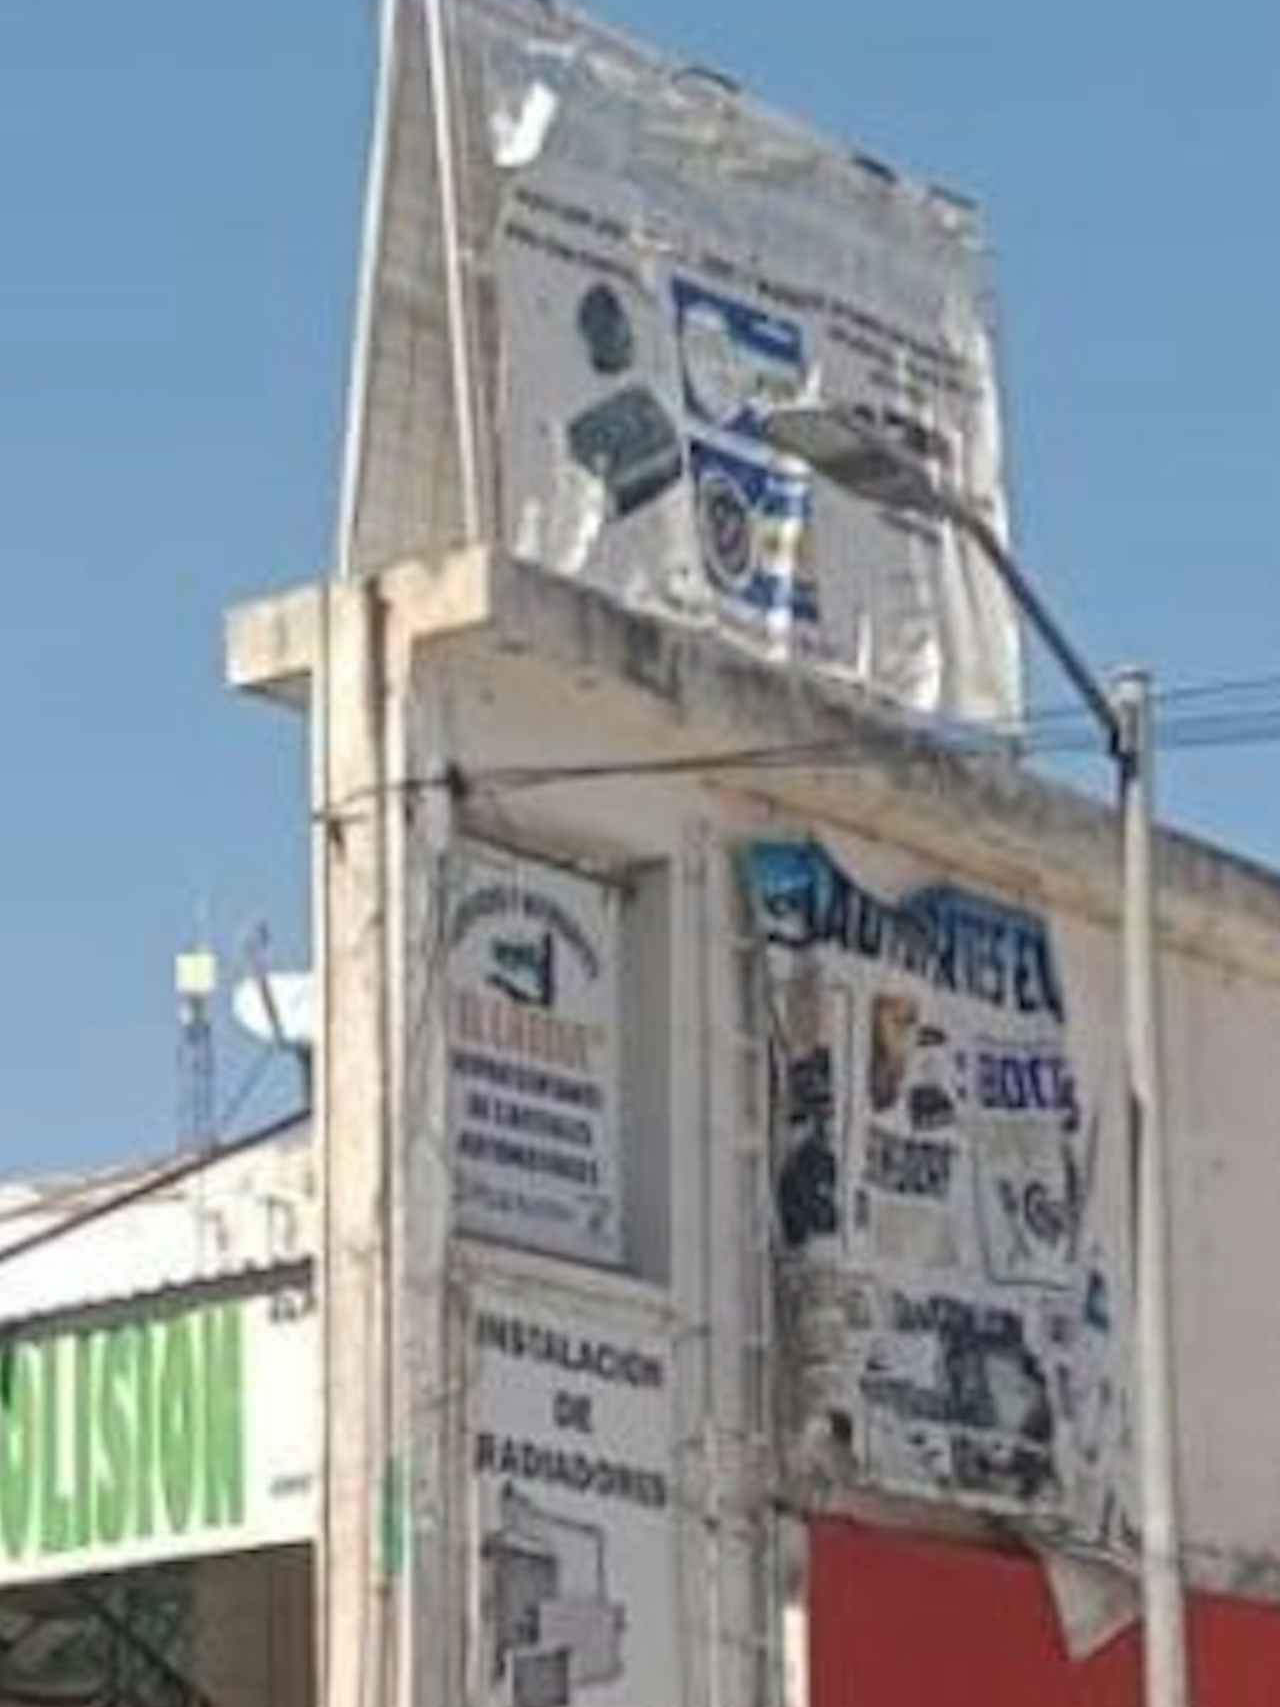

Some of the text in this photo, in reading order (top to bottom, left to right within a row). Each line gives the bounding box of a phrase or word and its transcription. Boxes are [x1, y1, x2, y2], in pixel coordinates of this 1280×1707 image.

[476, 1310, 664, 1388] INSTALACION
[552, 1389, 593, 1434] DE
[475, 1431, 668, 1510] RADIADORES
